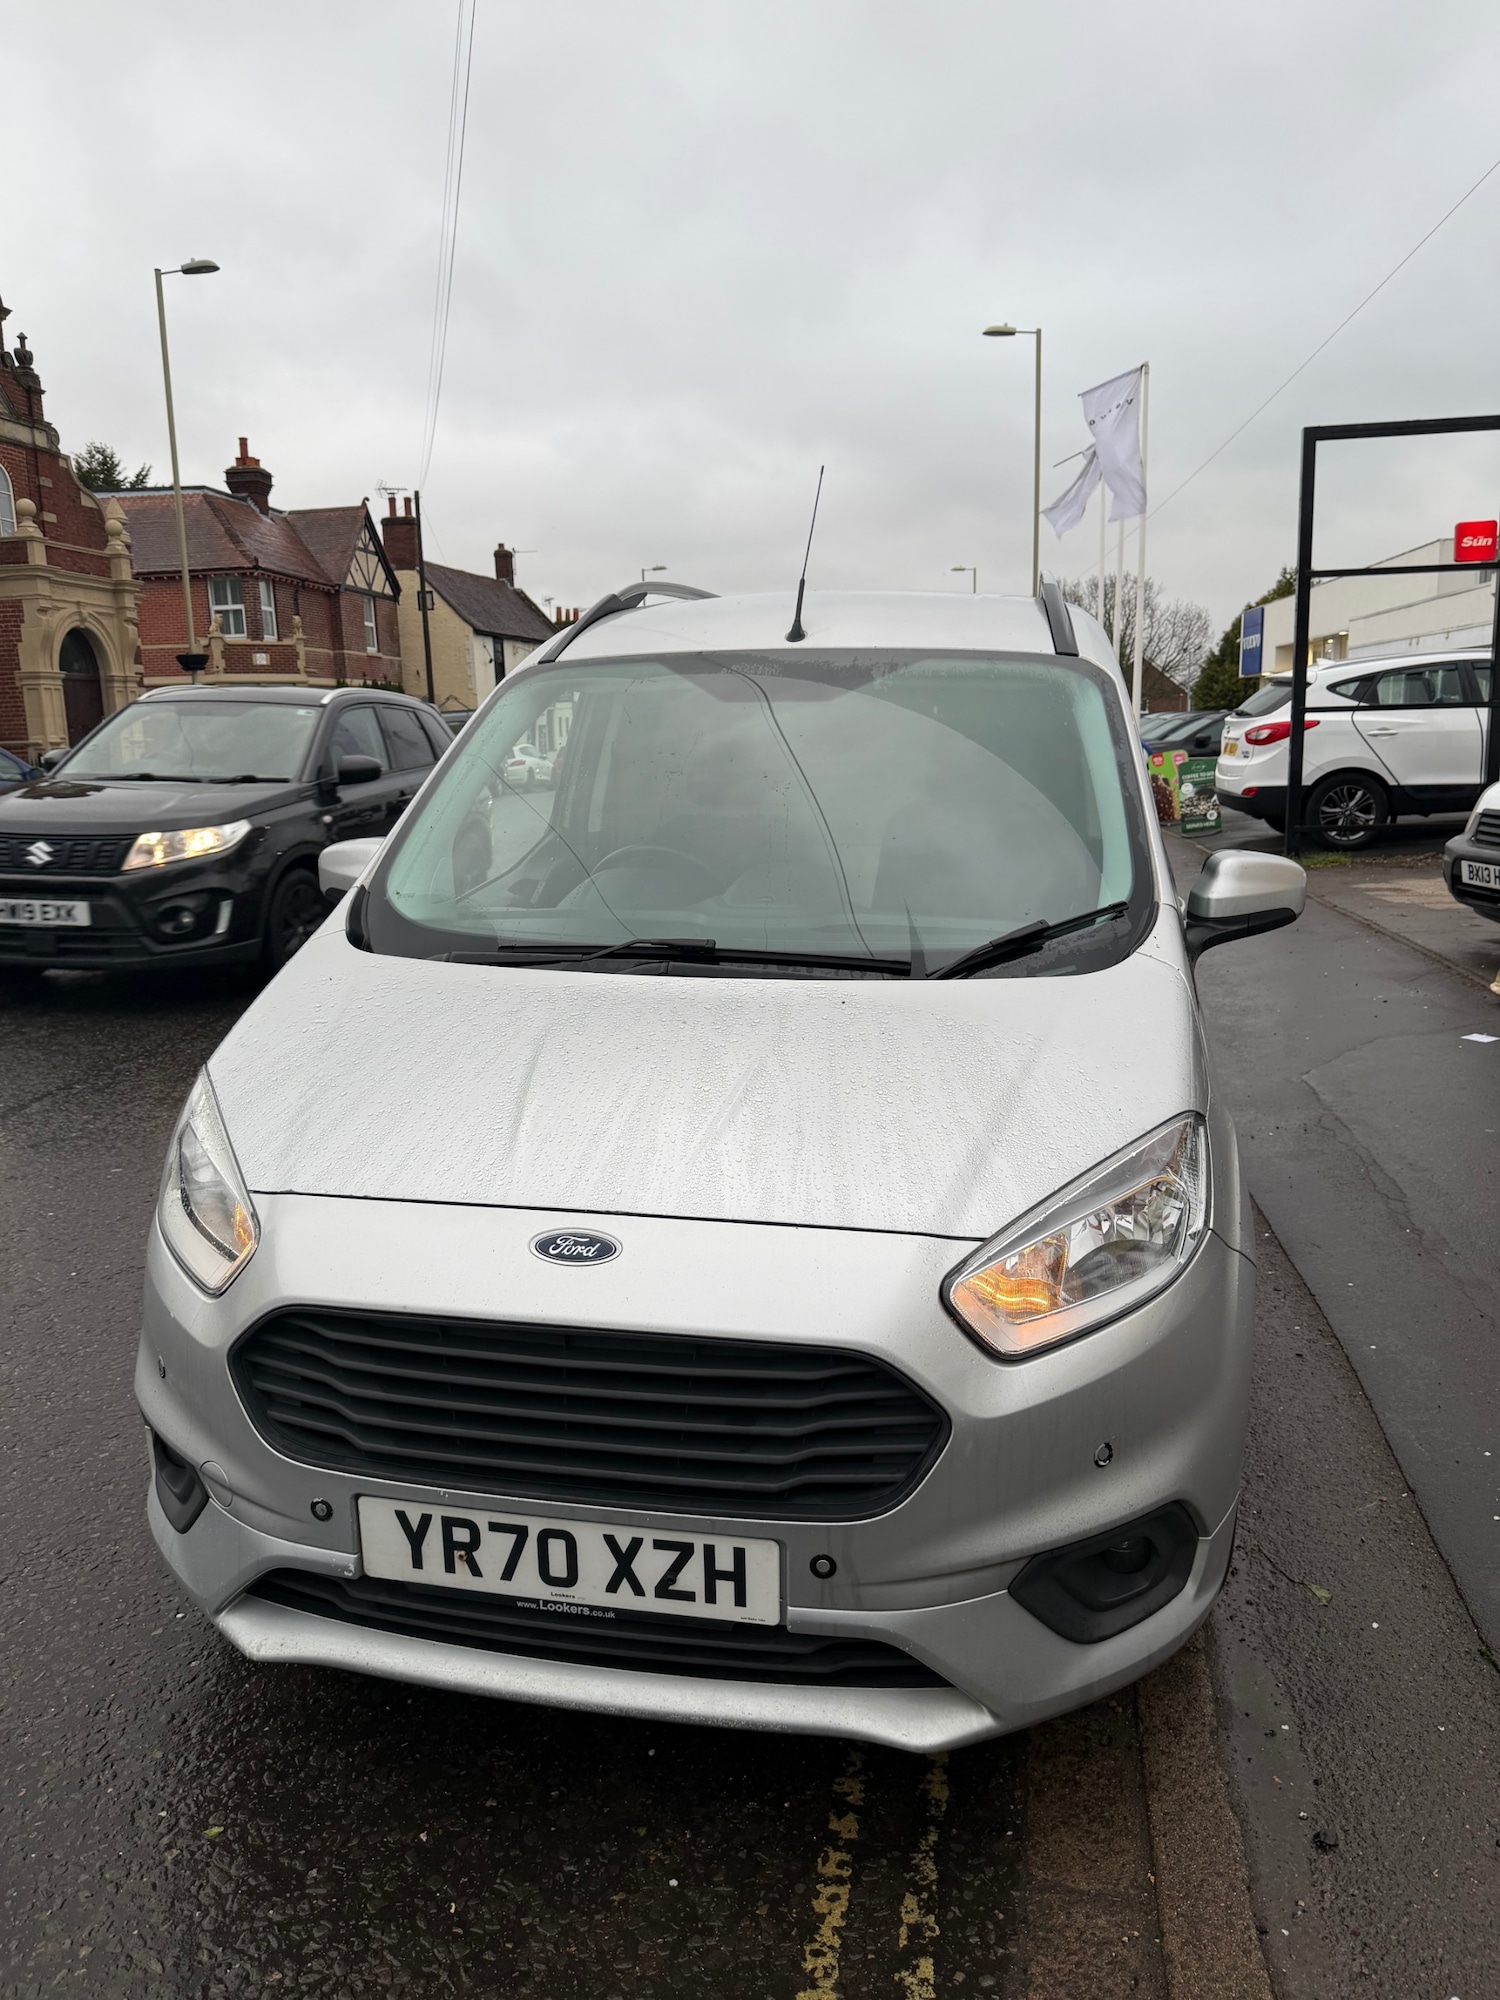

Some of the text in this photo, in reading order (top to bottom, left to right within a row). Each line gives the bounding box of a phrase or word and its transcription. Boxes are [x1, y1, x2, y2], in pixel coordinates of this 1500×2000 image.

[1243, 633, 1261, 650] VOLVO
[1182, 772, 1199, 780] COFFEE
[1468, 863, 1491, 884] BX13
[548, 1235, 601, 1257] Ford
[394, 1509, 747, 1608] YR70 XZH
[550, 1591, 576, 1599] Lookers
[516, 1600, 616, 1619] www.Lookers.co.uk
